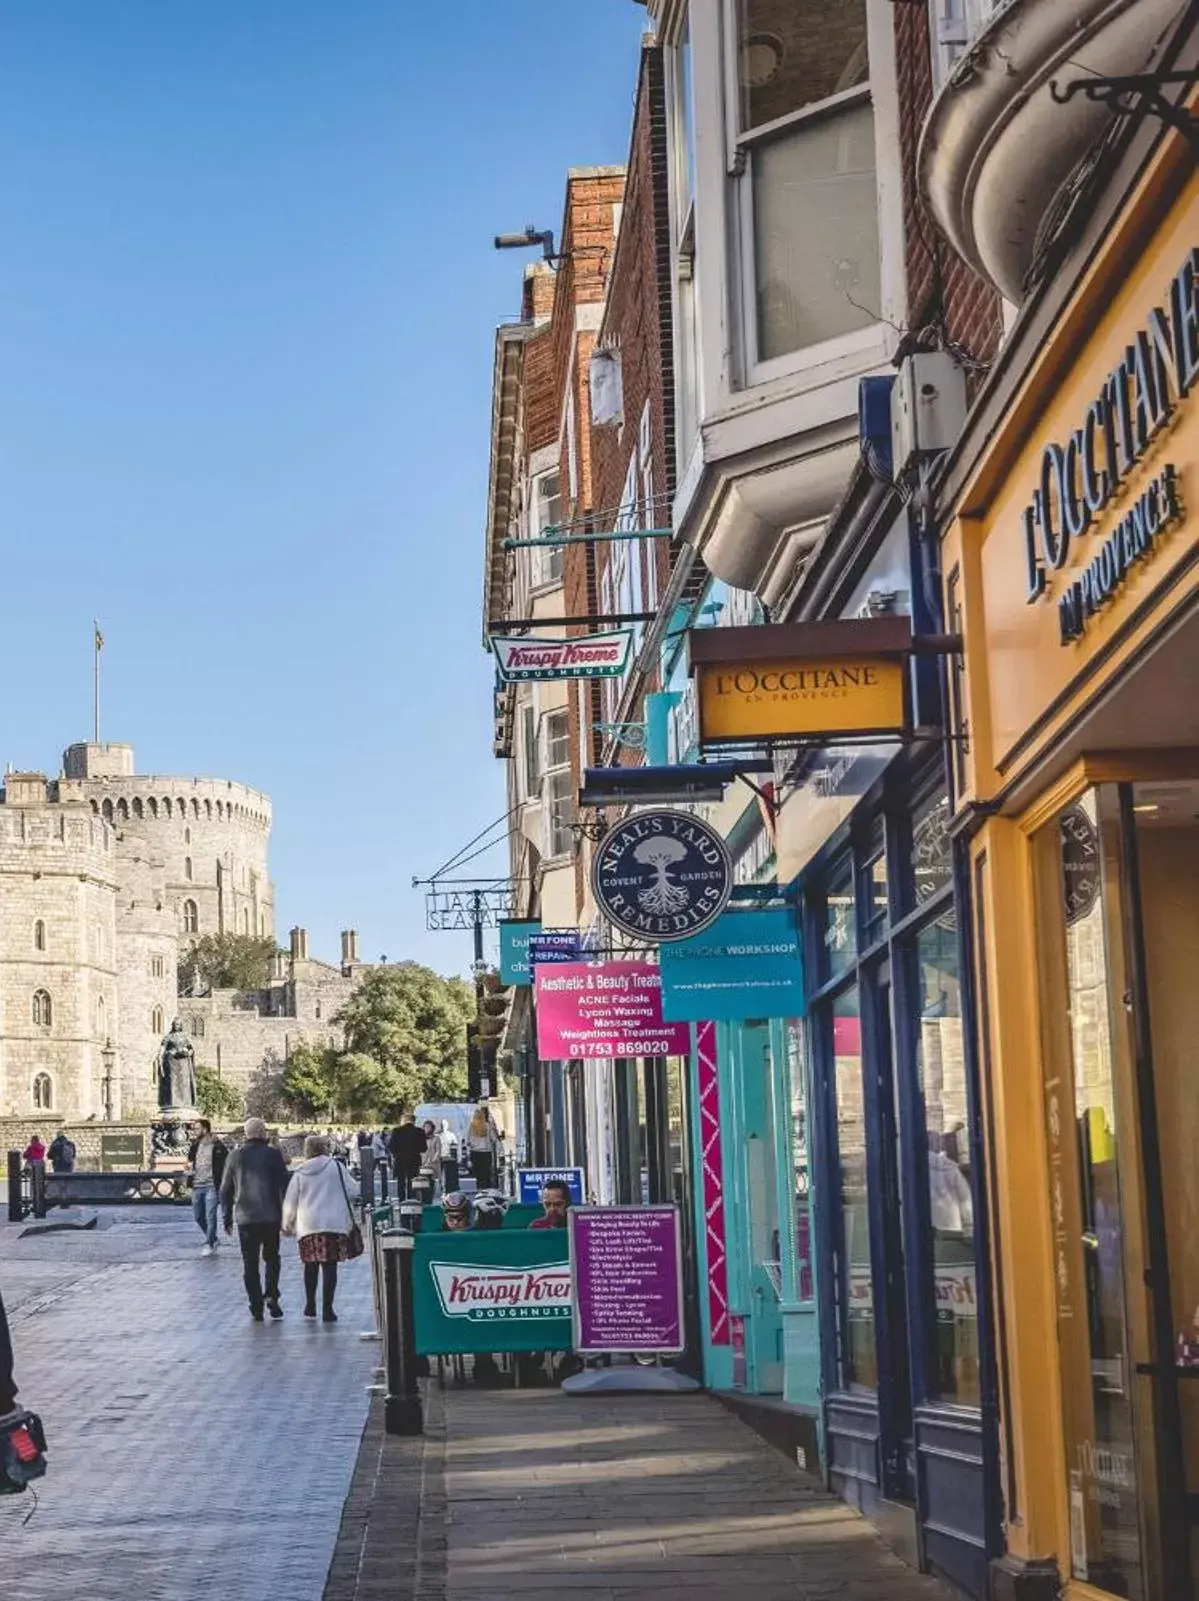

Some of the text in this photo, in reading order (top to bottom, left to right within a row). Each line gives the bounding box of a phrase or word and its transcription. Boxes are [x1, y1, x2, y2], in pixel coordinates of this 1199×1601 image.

[506, 641, 621, 668] Krispy Kreme
[715, 666, 878, 695] L'OCCITANE
[772, 690, 849, 703] PROVENCE
[602, 817, 720, 874] NEAL'S YARD
[603, 871, 722, 887] COVENT GARDEN
[608, 886, 720, 932] REMEDIES
[726, 943, 798, 956] WORKSHOP
[541, 976, 585, 991] Aesthetic
[587, 975, 595, 990] &
[596, 975, 630, 992] Beauty
[578, 994, 650, 1005] ACNE Facials
[614, 1007, 654, 1017] Waxing
[593, 1018, 642, 1028] Massage
[621, 1027, 677, 1038] Treatment
[569, 1041, 669, 1055] 01753 869020
[448, 1273, 571, 1306] Krispy Kre
[475, 1307, 570, 1318] DOUGHNUTS
